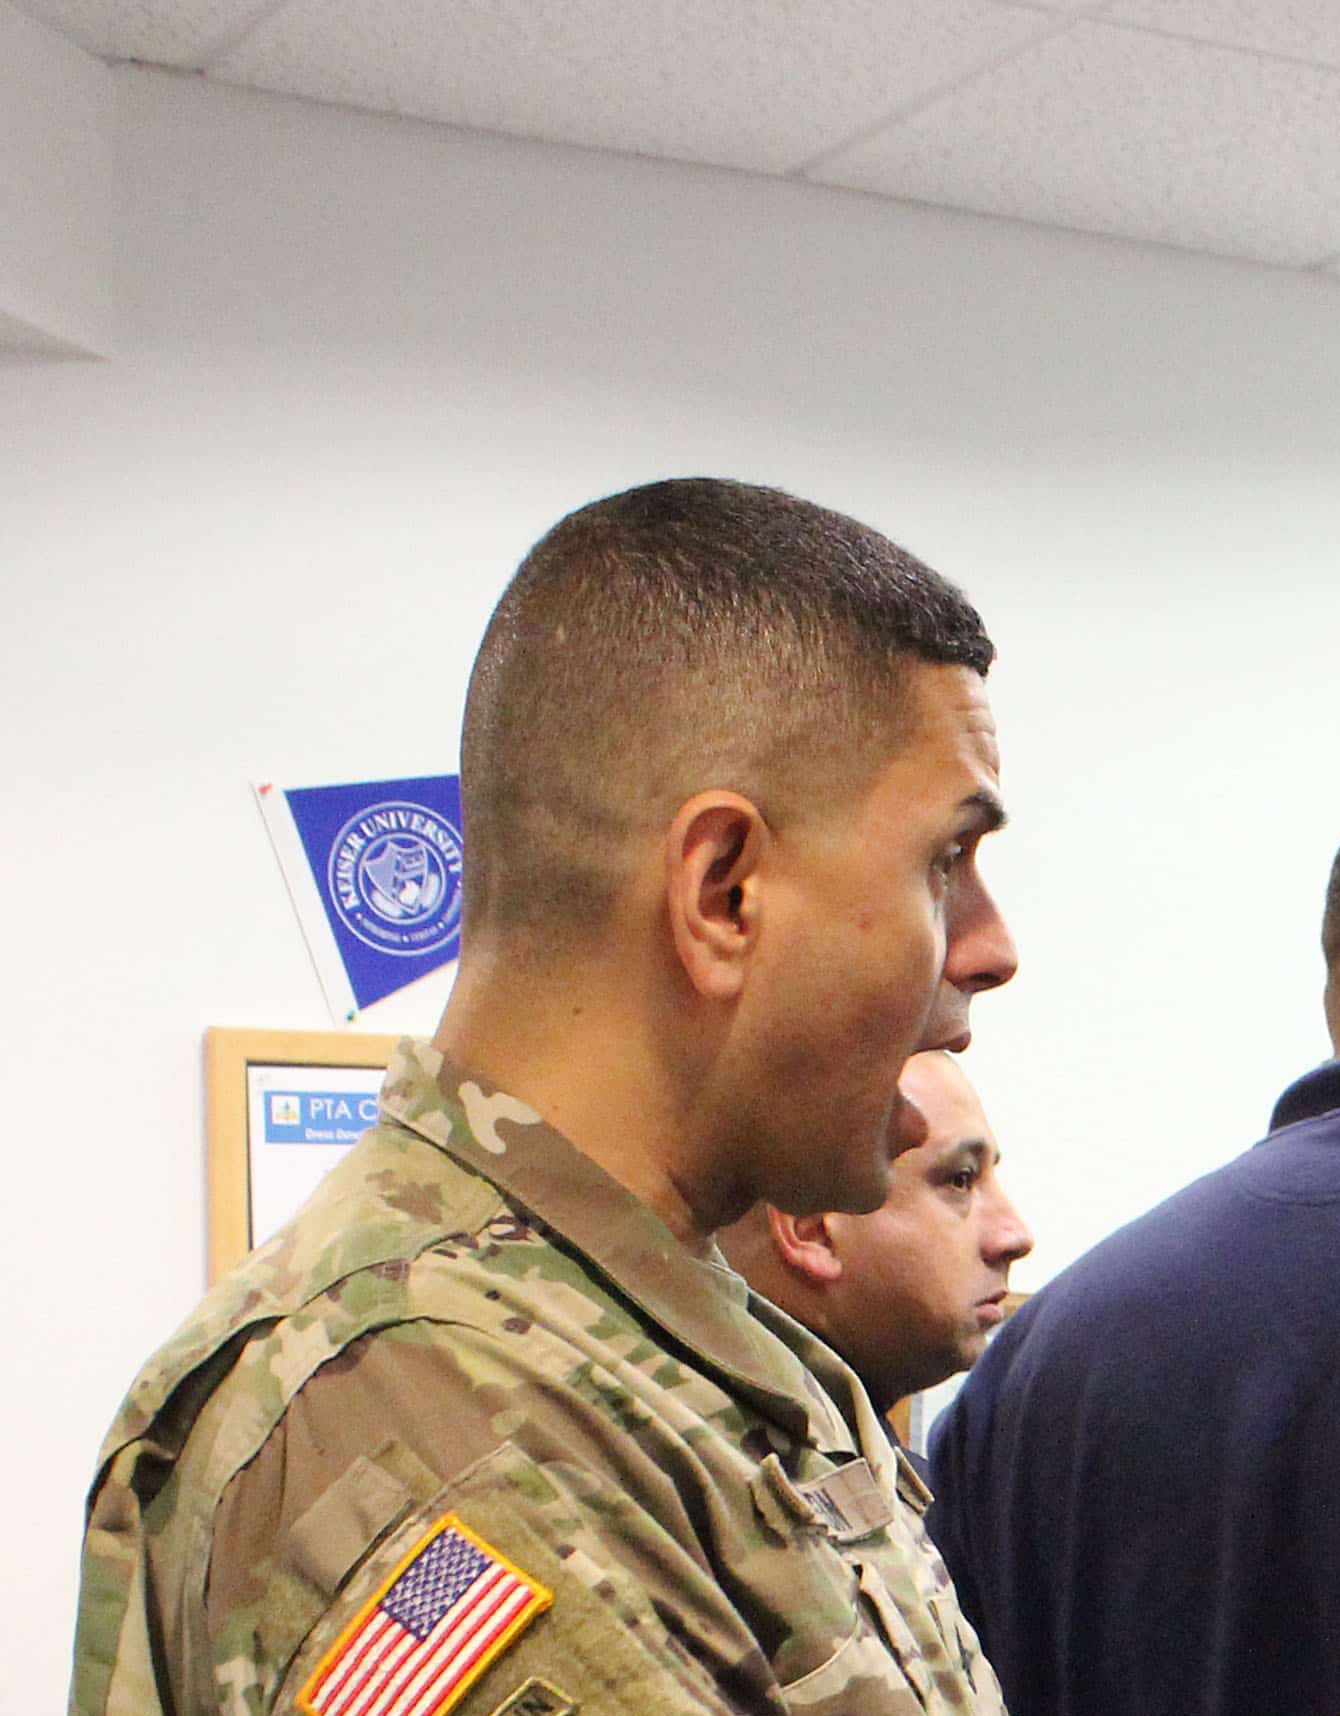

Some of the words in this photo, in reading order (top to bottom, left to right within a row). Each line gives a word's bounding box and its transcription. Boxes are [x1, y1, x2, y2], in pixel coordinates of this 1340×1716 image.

[336, 831, 366, 911] KEISER
[360, 811, 463, 873] UNIVERSITY
[309, 1098, 352, 1120] PTA
